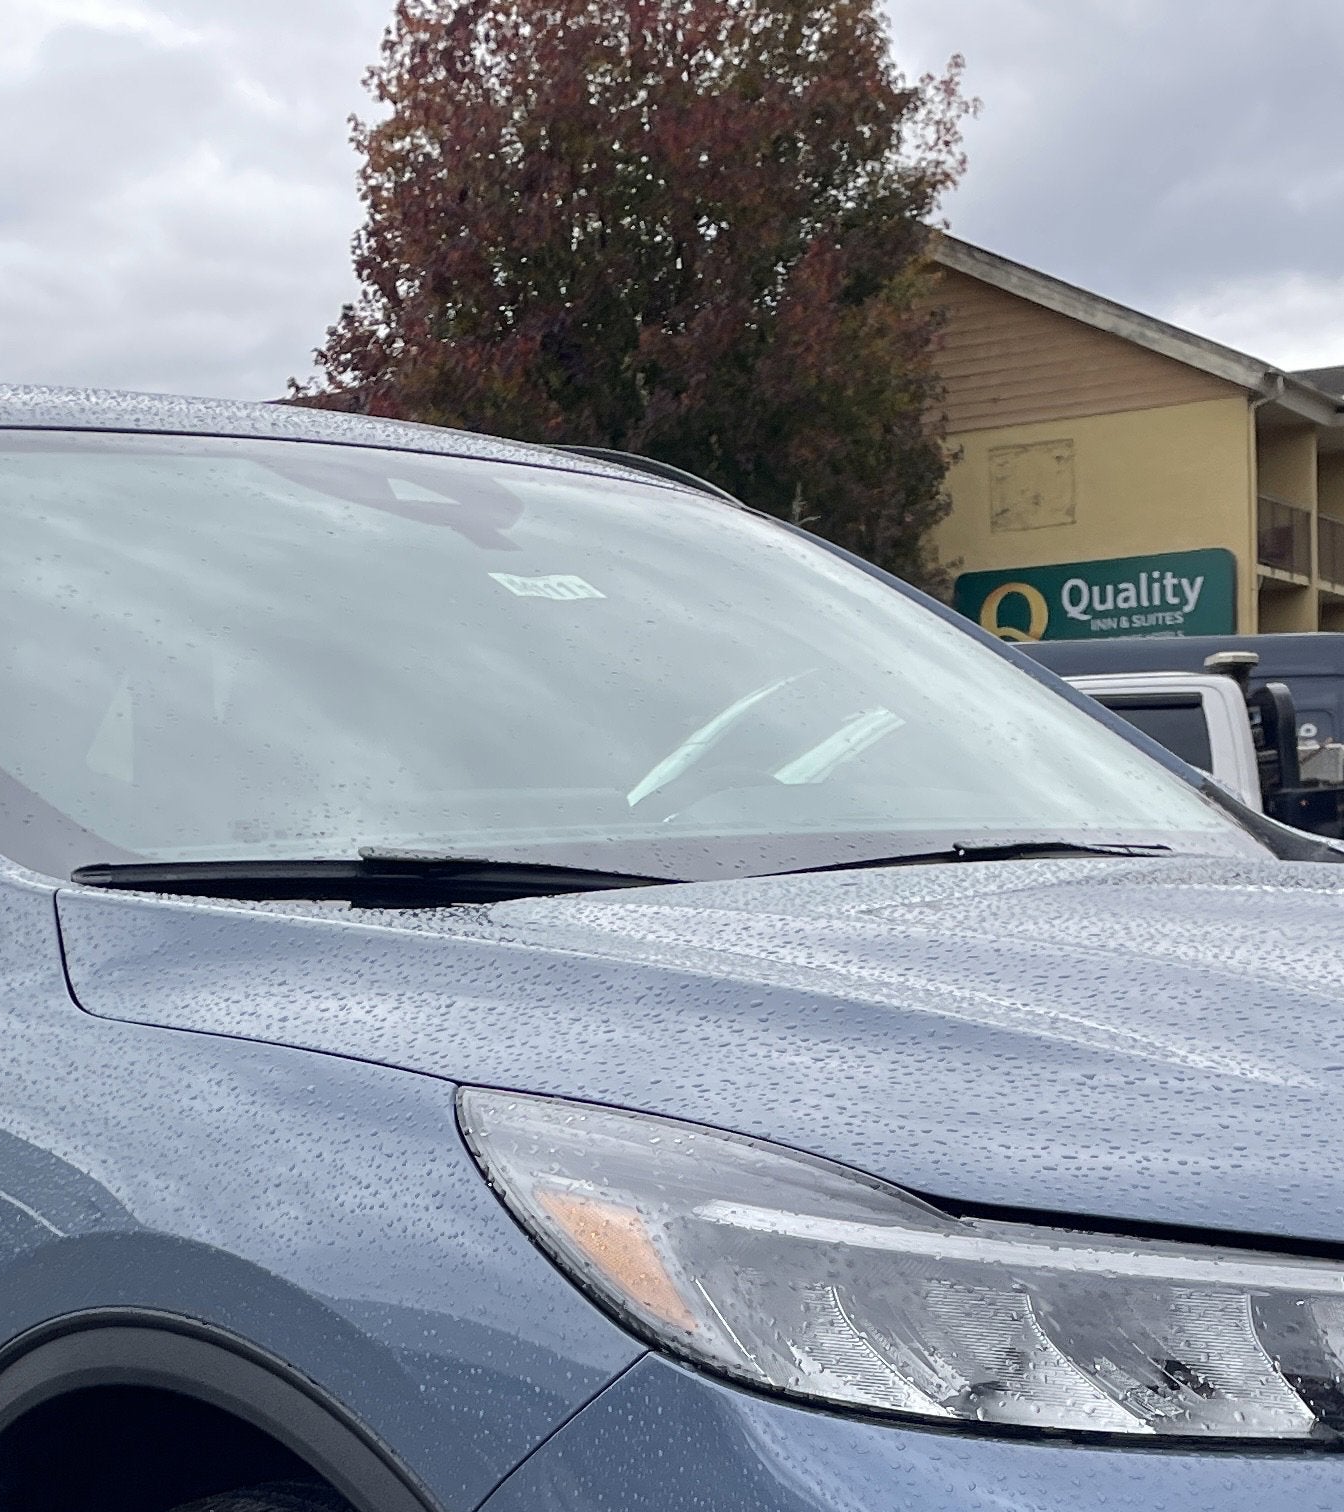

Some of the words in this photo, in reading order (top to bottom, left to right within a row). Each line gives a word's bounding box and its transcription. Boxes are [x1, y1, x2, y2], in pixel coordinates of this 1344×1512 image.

[980, 582, 1049, 642] Q
[1061, 571, 1205, 621] Quality
[1091, 617, 1118, 631] INN
[1131, 611, 1185, 627] SUITES
